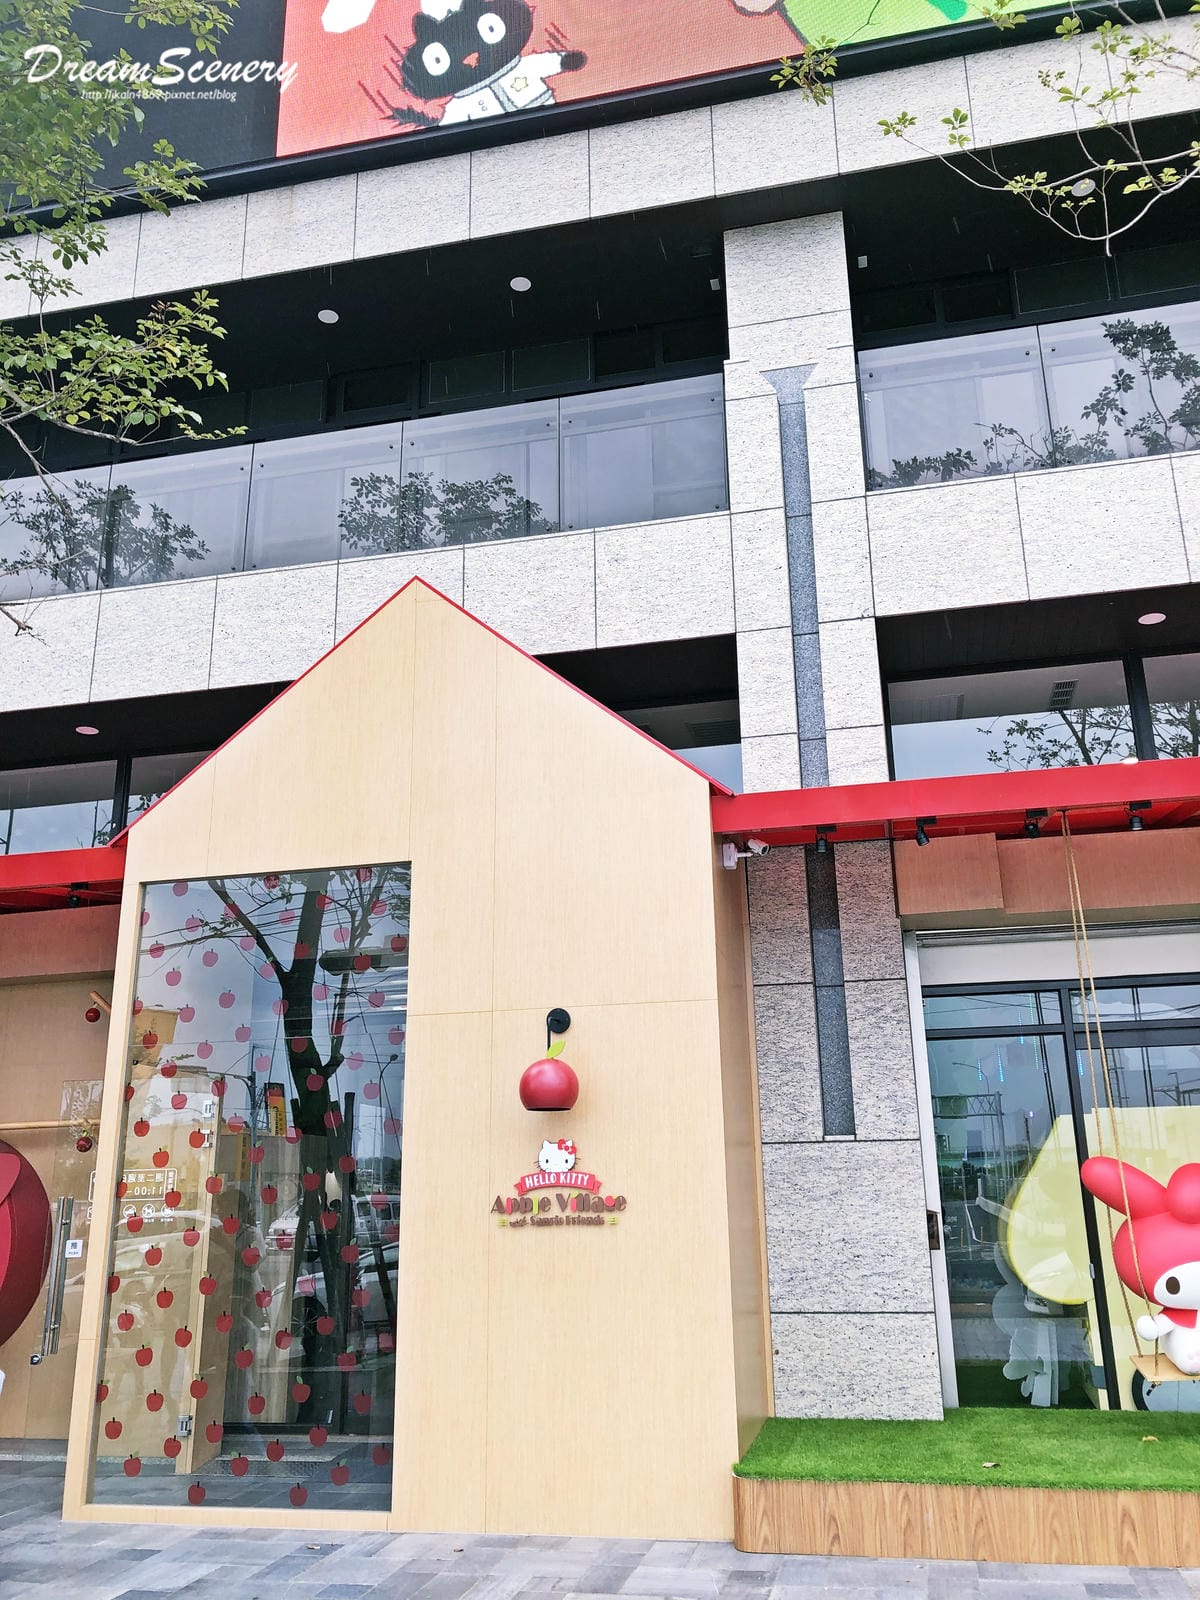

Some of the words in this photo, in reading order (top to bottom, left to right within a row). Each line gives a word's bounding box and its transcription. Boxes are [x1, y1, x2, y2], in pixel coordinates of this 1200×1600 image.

[525, 1173, 557, 1189] HELLO
[560, 1172, 590, 1186] KITTY
[491, 1195, 552, 1215] Apple
[555, 1191, 627, 1213] Village
[530, 1215, 564, 1226] Sanrio
[565, 1214, 605, 1226] Friends
